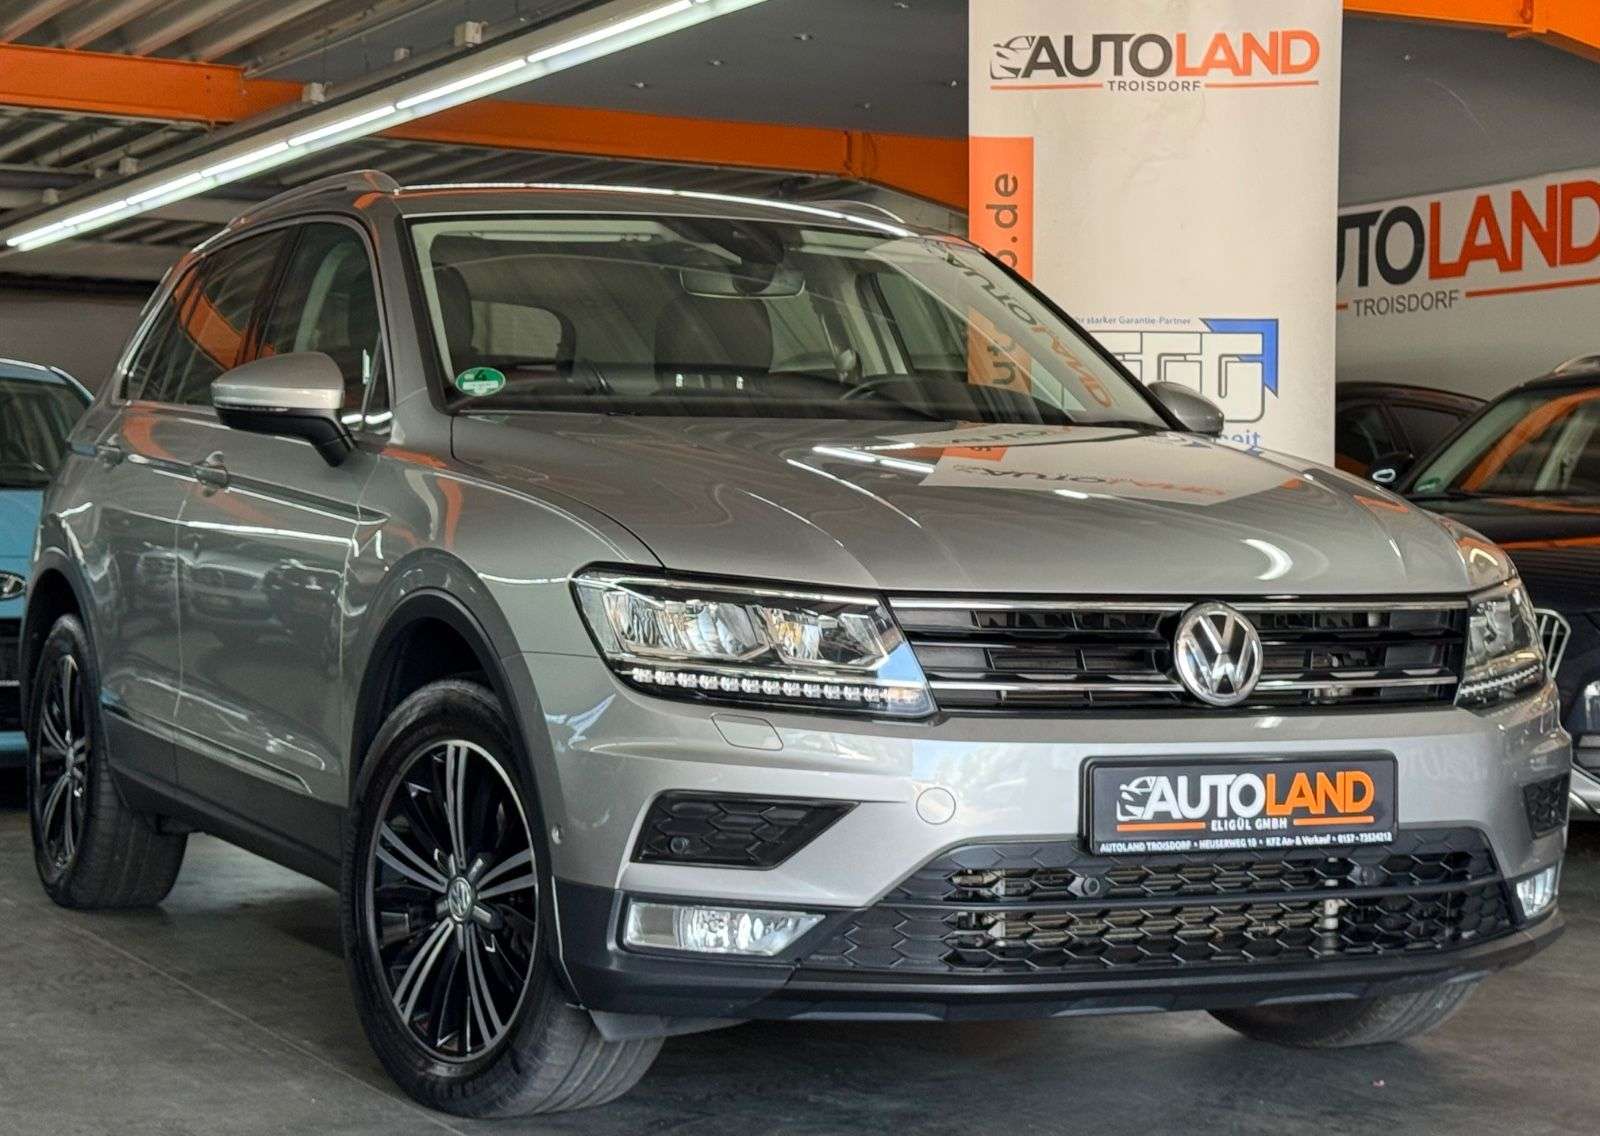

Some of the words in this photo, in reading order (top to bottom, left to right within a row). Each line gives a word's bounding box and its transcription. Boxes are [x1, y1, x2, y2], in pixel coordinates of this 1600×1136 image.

[1021, 30, 1320, 78] AUTOLAND
[1107, 80, 1201, 92] TROISDORF
[1353, 289, 1460, 317] TROISDORF
[1086, 314, 1116, 325] starker
[1142, 771, 1375, 820] AUTOLAND
[1211, 817, 1252, 832] ELIGÜL
[1100, 842, 1146, 853] AUTOLAND
[1146, 840, 1192, 851] TROISDORF
